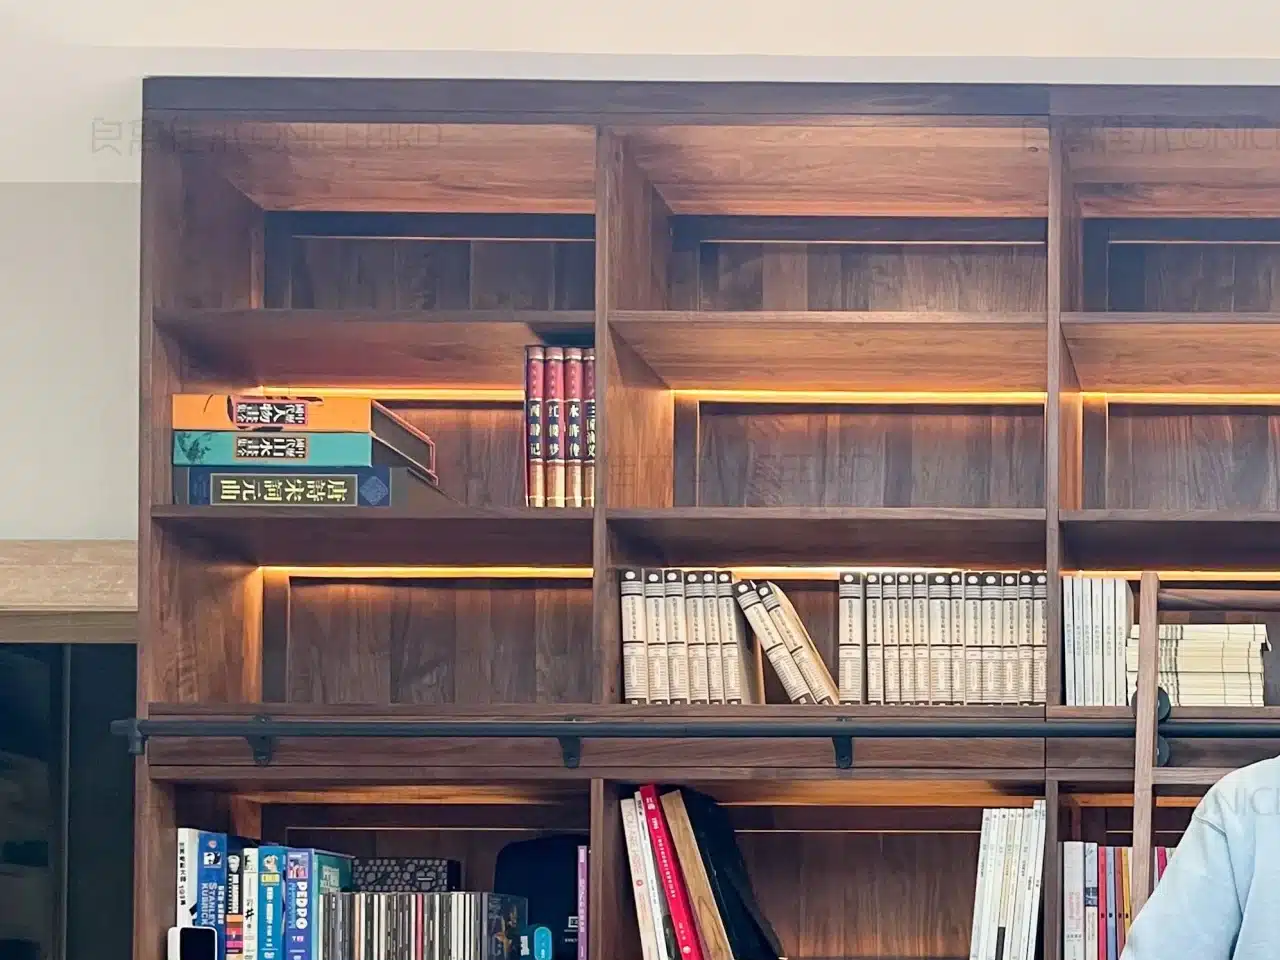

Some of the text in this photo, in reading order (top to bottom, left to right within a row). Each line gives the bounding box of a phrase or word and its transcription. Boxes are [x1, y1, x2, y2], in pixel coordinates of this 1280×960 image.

[568, 404, 580, 457] 水浒传
[219, 479, 348, 502] 唐詩宋詞元曲
[200, 882, 209, 926] KUBRICK
[208, 882, 217, 927] STANLEY
